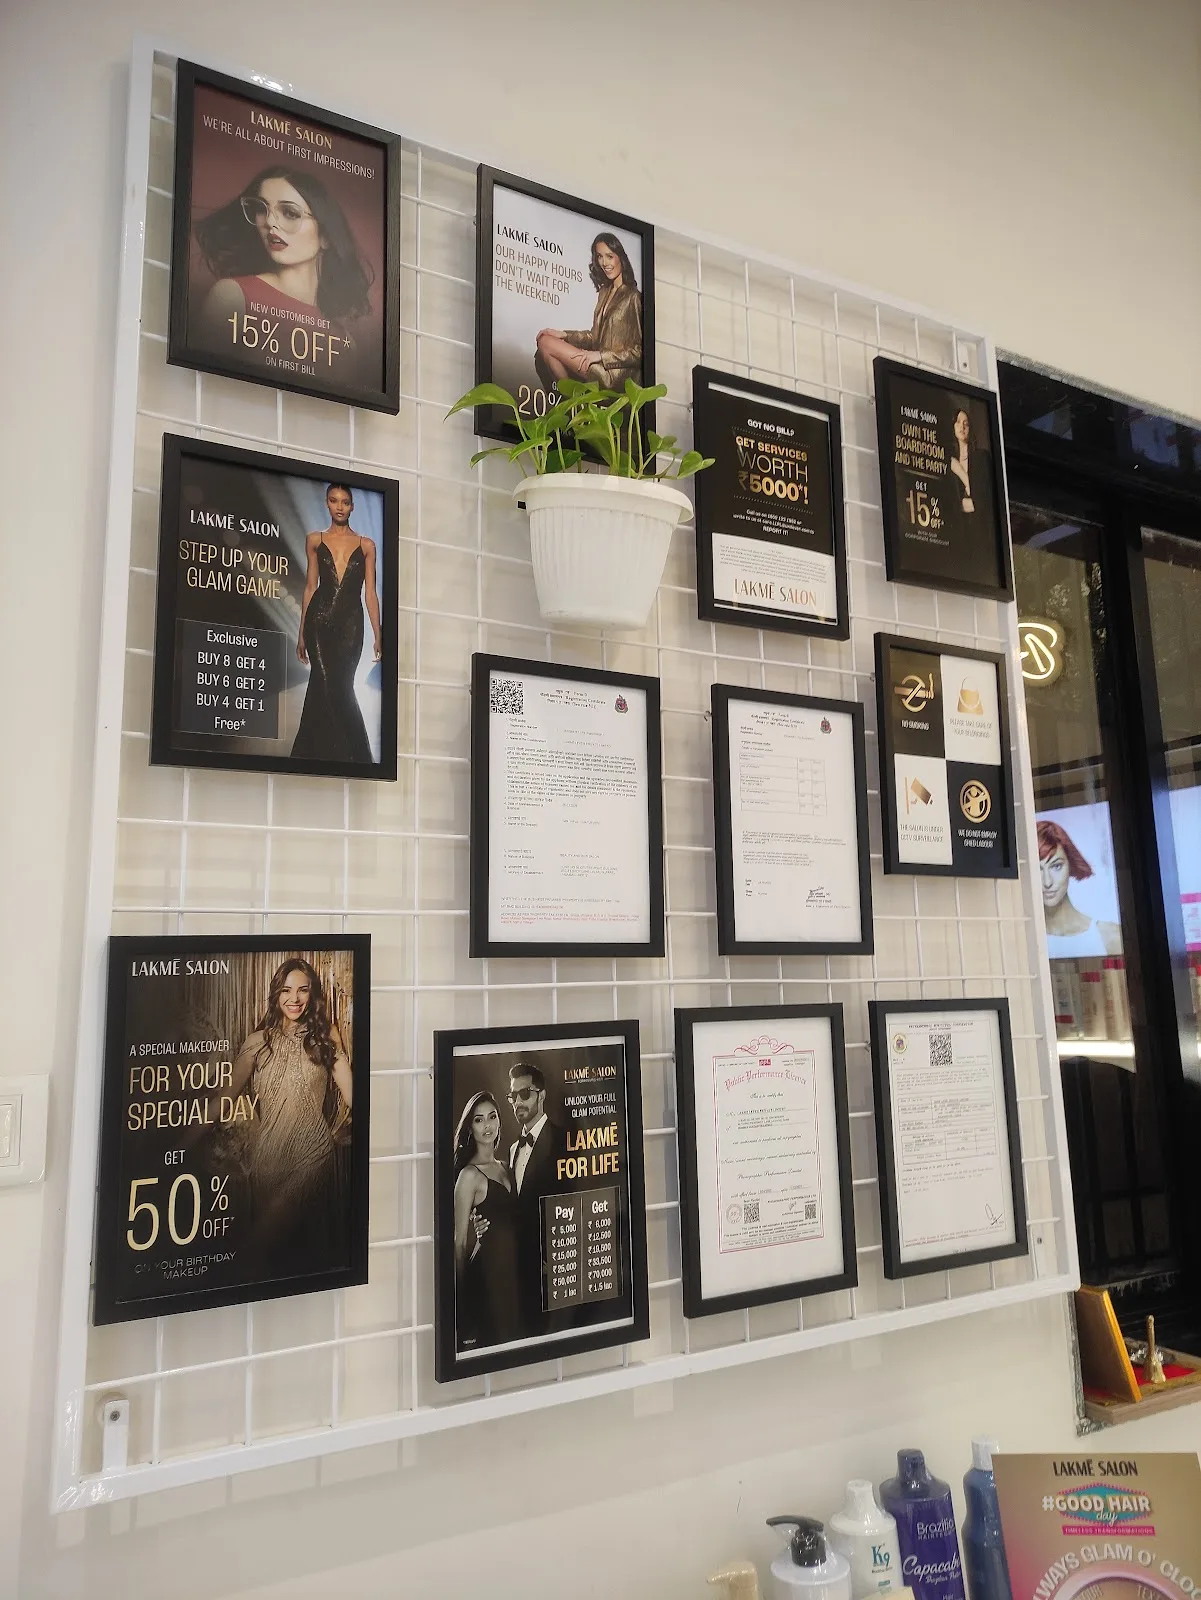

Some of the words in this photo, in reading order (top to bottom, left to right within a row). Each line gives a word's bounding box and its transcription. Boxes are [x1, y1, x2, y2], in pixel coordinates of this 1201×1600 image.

[203, 115, 232, 135] WE'RE
[235, 126, 251, 141] ALL
[254, 133, 285, 152] ABOUT
[287, 144, 311, 160] FIRST
[314, 152, 376, 180] IMPRESSIONS!
[296, 126, 332, 150] SALON
[533, 236, 564, 256] SALON
[496, 243, 515, 260] OUR
[518, 252, 549, 271] HAPPY
[552, 262, 583, 282] HOURS
[495, 259, 524, 278] DON'T
[526, 270, 550, 288] WAIT
[552, 278, 570, 294] FOR
[495, 274, 513, 292] THE
[516, 281, 560, 306] WEEKEND
[250, 302, 269, 314] NEW
[270, 306, 315, 326] CUSTOMERS
[317, 318, 331, 330] GET
[228, 311, 280, 354] 15%
[266, 356, 277, 367] ON
[278, 359, 300, 372] FIRST
[301, 364, 316, 376] BILL
[747, 418, 762, 430] GOT
[763, 423, 776, 433] NO
[902, 422, 921, 439] OWN
[922, 427, 937, 444] THE
[736, 435, 756, 449] GET
[758, 441, 808, 462] SERVICES
[896, 434, 945, 460] BOARDROOM
[736, 448, 808, 484] WORTH
[894, 450, 910, 466] AND
[911, 455, 925, 470] THE
[926, 458, 948, 475] PARTY
[916, 480, 928, 492] GET
[240, 518, 280, 538] SALON
[180, 540, 218, 564] STEP
[222, 546, 243, 568] UP
[248, 551, 288, 576] YOUR
[186, 566, 232, 592] GLAM
[236, 574, 280, 600] GAME
[780, 586, 817, 608] SALON
[207, 630, 258, 648] Exclusive
[198, 652, 220, 666] BUY
[224, 654, 230, 667] 8
[236, 656, 256, 670] GET
[258, 659, 266, 670] 4
[197, 672, 220, 686] BUY
[222, 675, 230, 688] 6
[236, 676, 256, 690] GET
[258, 679, 265, 692] 2
[196, 692, 220, 706] BUY
[222, 696, 230, 708] 4
[235, 697, 255, 710] GET
[258, 700, 264, 712] 1
[186, 960, 230, 976] SALON
[129, 1044, 136, 1057] A
[139, 1042, 177, 1056] SPECIAL
[180, 1040, 230, 1054] MAKEOVER
[130, 1066, 170, 1094] FOR
[176, 1061, 233, 1091] YOUR
[592, 1065, 617, 1078] SALON
[564, 1096, 588, 1106] UNLOCK
[589, 1094, 603, 1104] YOUR
[604, 1092, 616, 1102] FULL
[128, 1098, 214, 1131] SPECIAL
[220, 1094, 260, 1123] DAY
[571, 1107, 587, 1118] GLAM
[589, 1105, 617, 1117] POTENTIAL
[164, 1150, 186, 1166] GET
[557, 1156, 588, 1180] FOR
[592, 1152, 620, 1176] LIFE
[555, 1206, 574, 1221] Pay
[592, 1200, 608, 1214] Get
[186, 1252, 236, 1266] BIRTHDAY
[164, 1266, 208, 1280] MAKEUP
[1098, 1460, 1138, 1477] SALON
[1042, 1495, 1104, 1512] #GOOD
[1108, 1495, 1151, 1512] HAIR
[1096, 1509, 1118, 1528] day
[1080, 1543, 1133, 1564] GLAM
